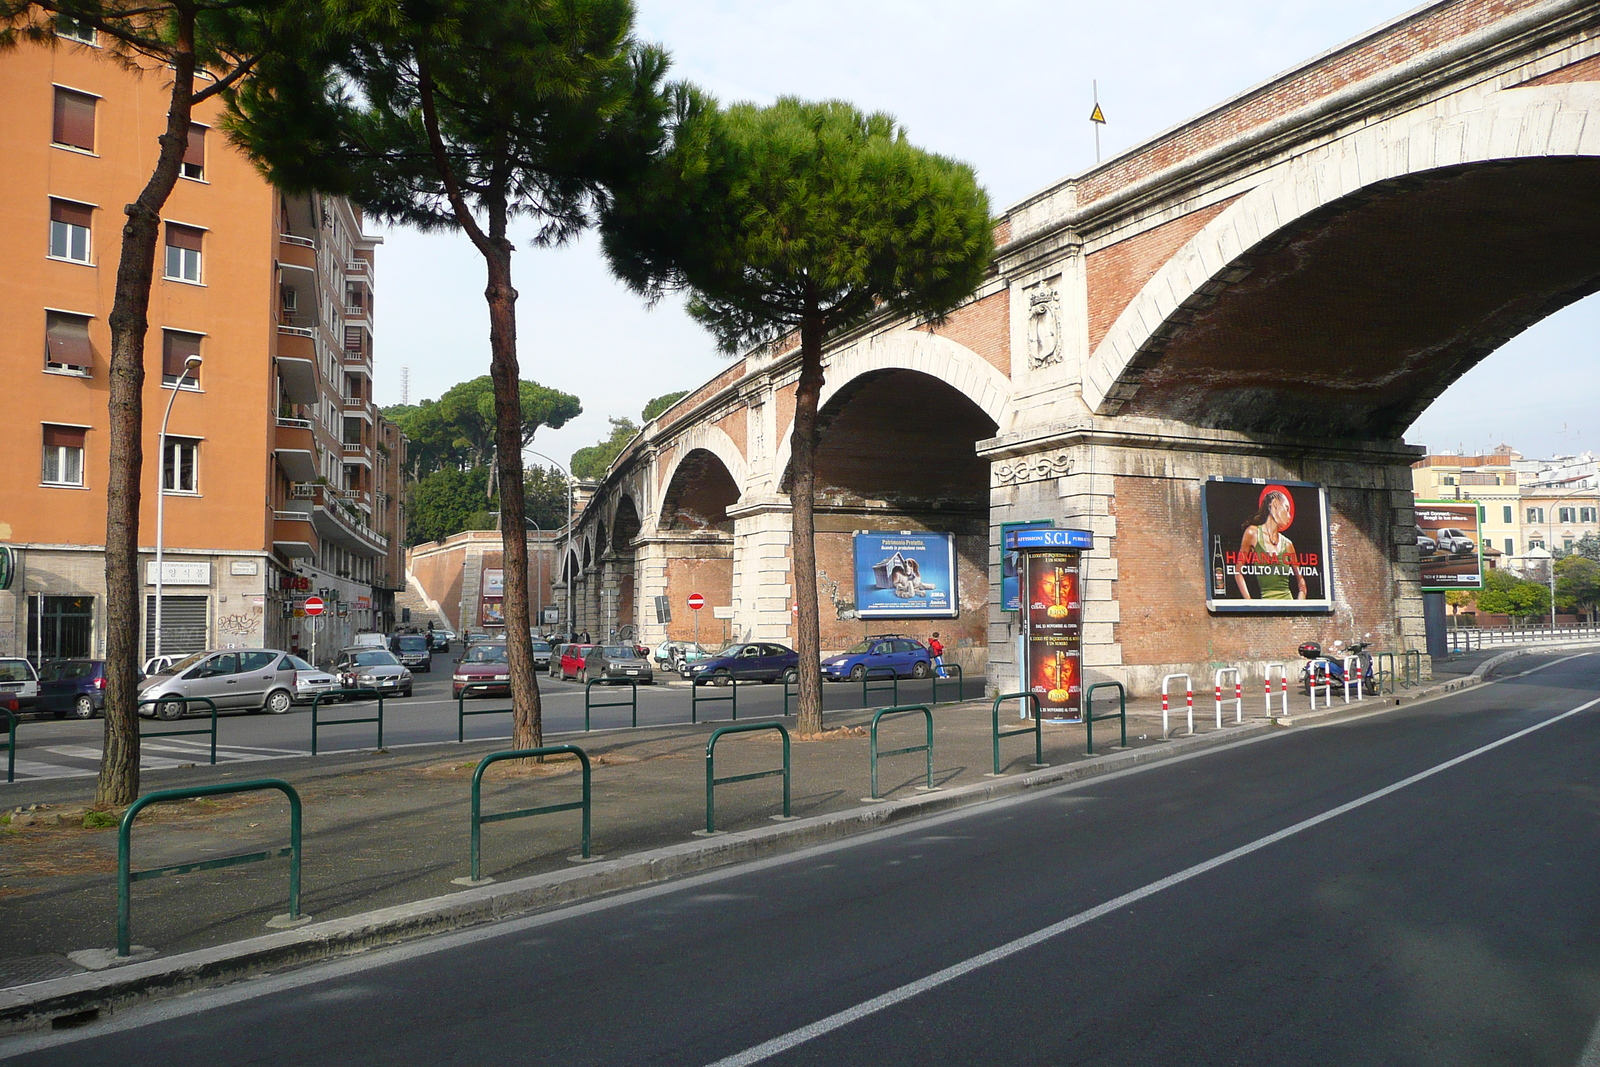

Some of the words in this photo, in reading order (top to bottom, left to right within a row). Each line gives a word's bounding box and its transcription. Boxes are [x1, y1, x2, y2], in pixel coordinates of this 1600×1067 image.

[1044, 532, 1071, 544] S.C.I.
[1225, 551, 1280, 565] HAVANA
[1282, 553, 1318, 565] CLUB
[1227, 565, 1239, 575] EL
[1241, 566, 1271, 575] CULTO
[1274, 566, 1280, 575] A
[1282, 567, 1294, 575] LA
[1297, 567, 1318, 576] VIDA
